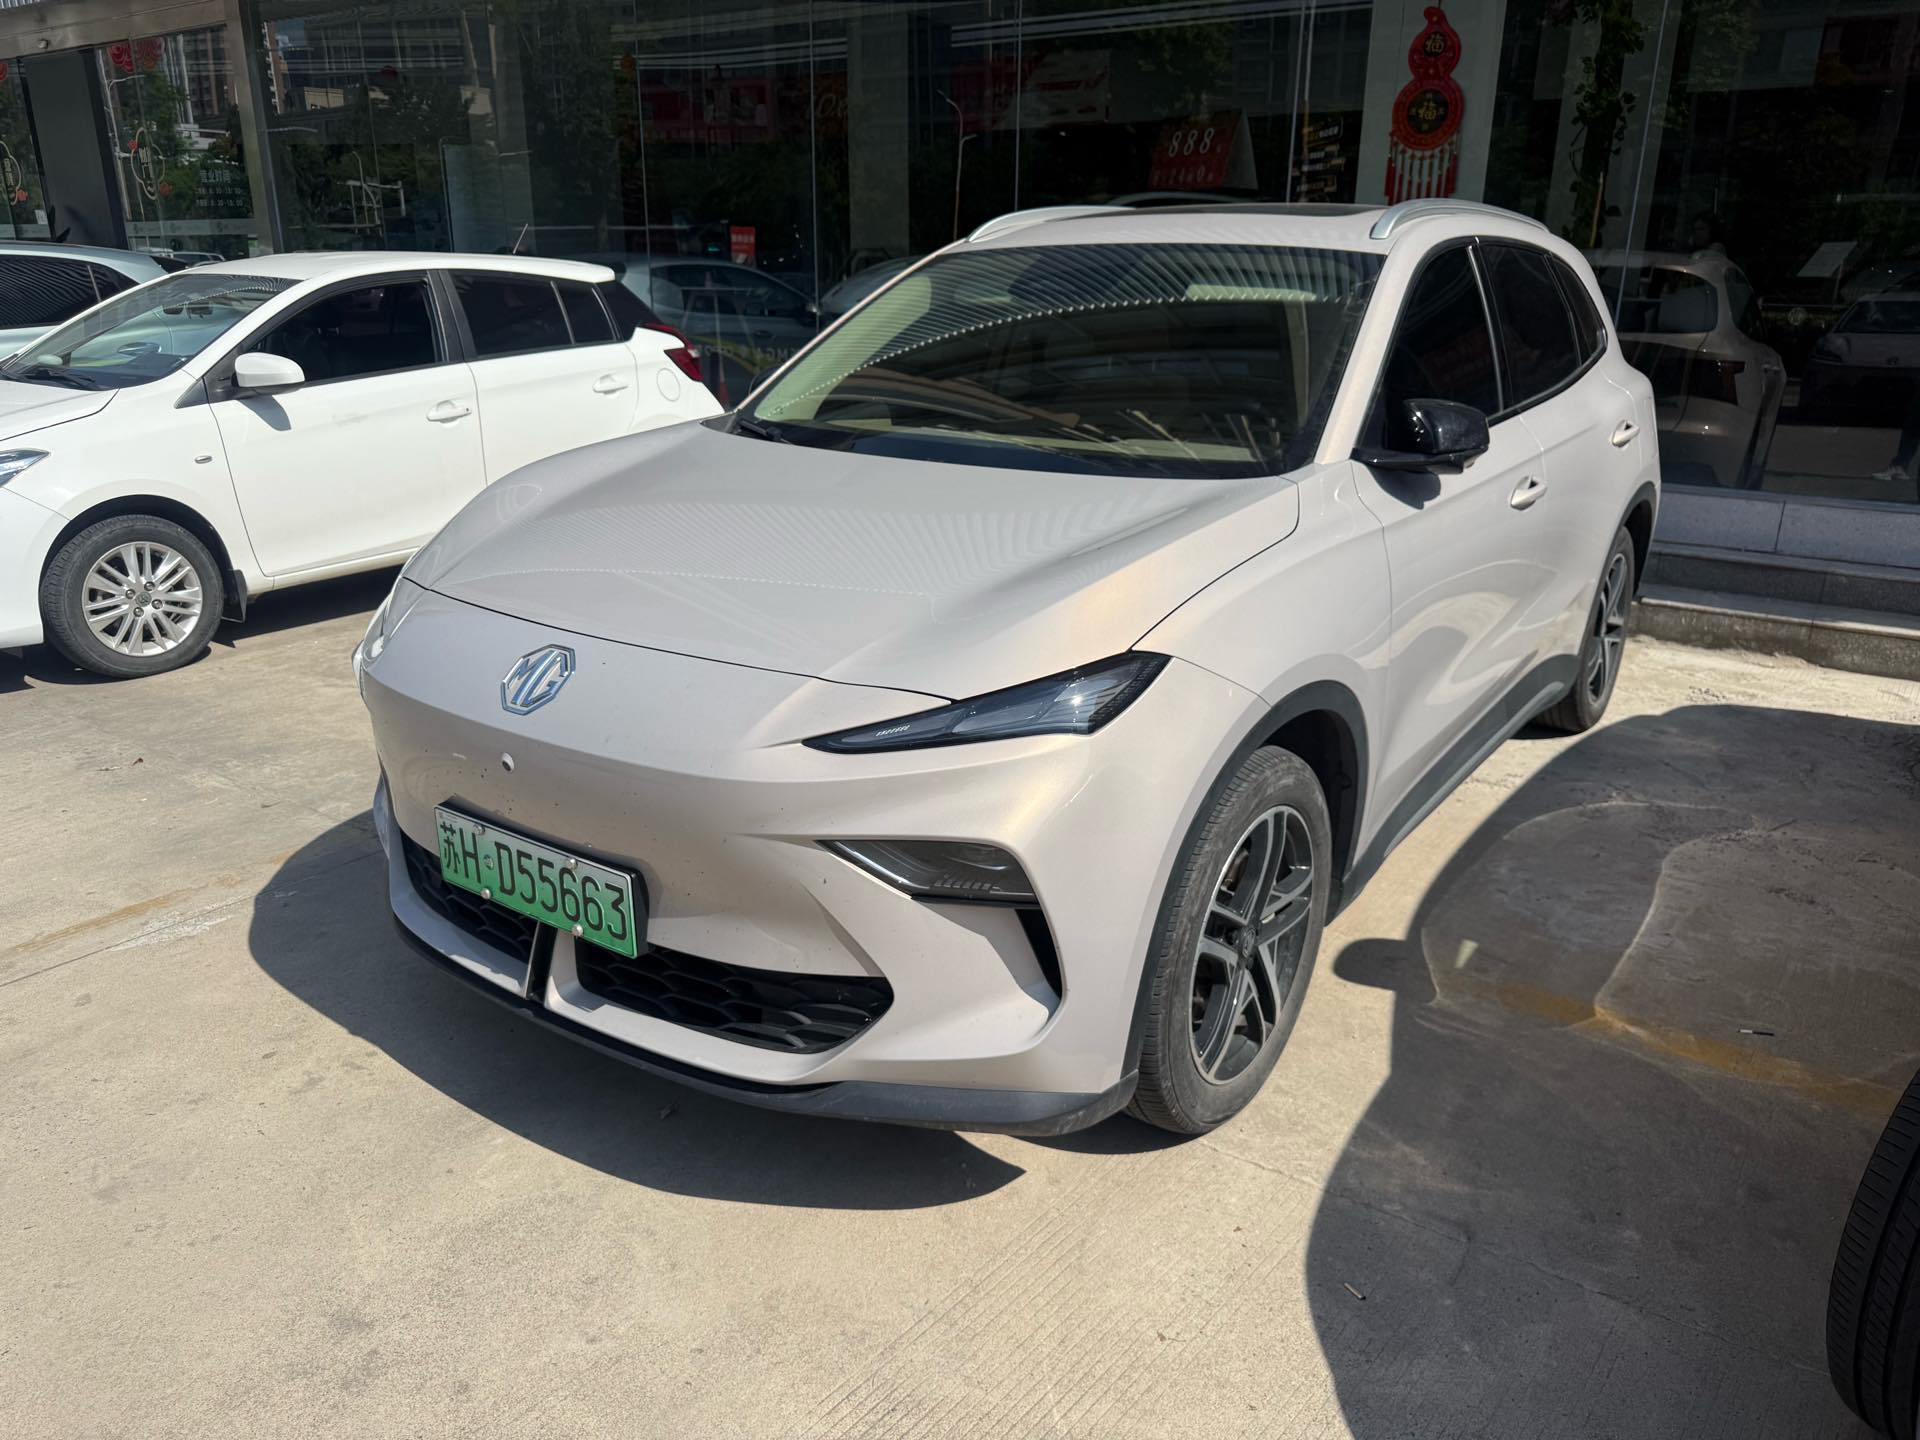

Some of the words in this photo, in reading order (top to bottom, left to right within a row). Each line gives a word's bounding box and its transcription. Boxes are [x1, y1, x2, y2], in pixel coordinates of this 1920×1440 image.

[1424, 32, 1445, 53] 福
[1168, 127, 1215, 158] 888
[506, 648, 572, 709] MG
